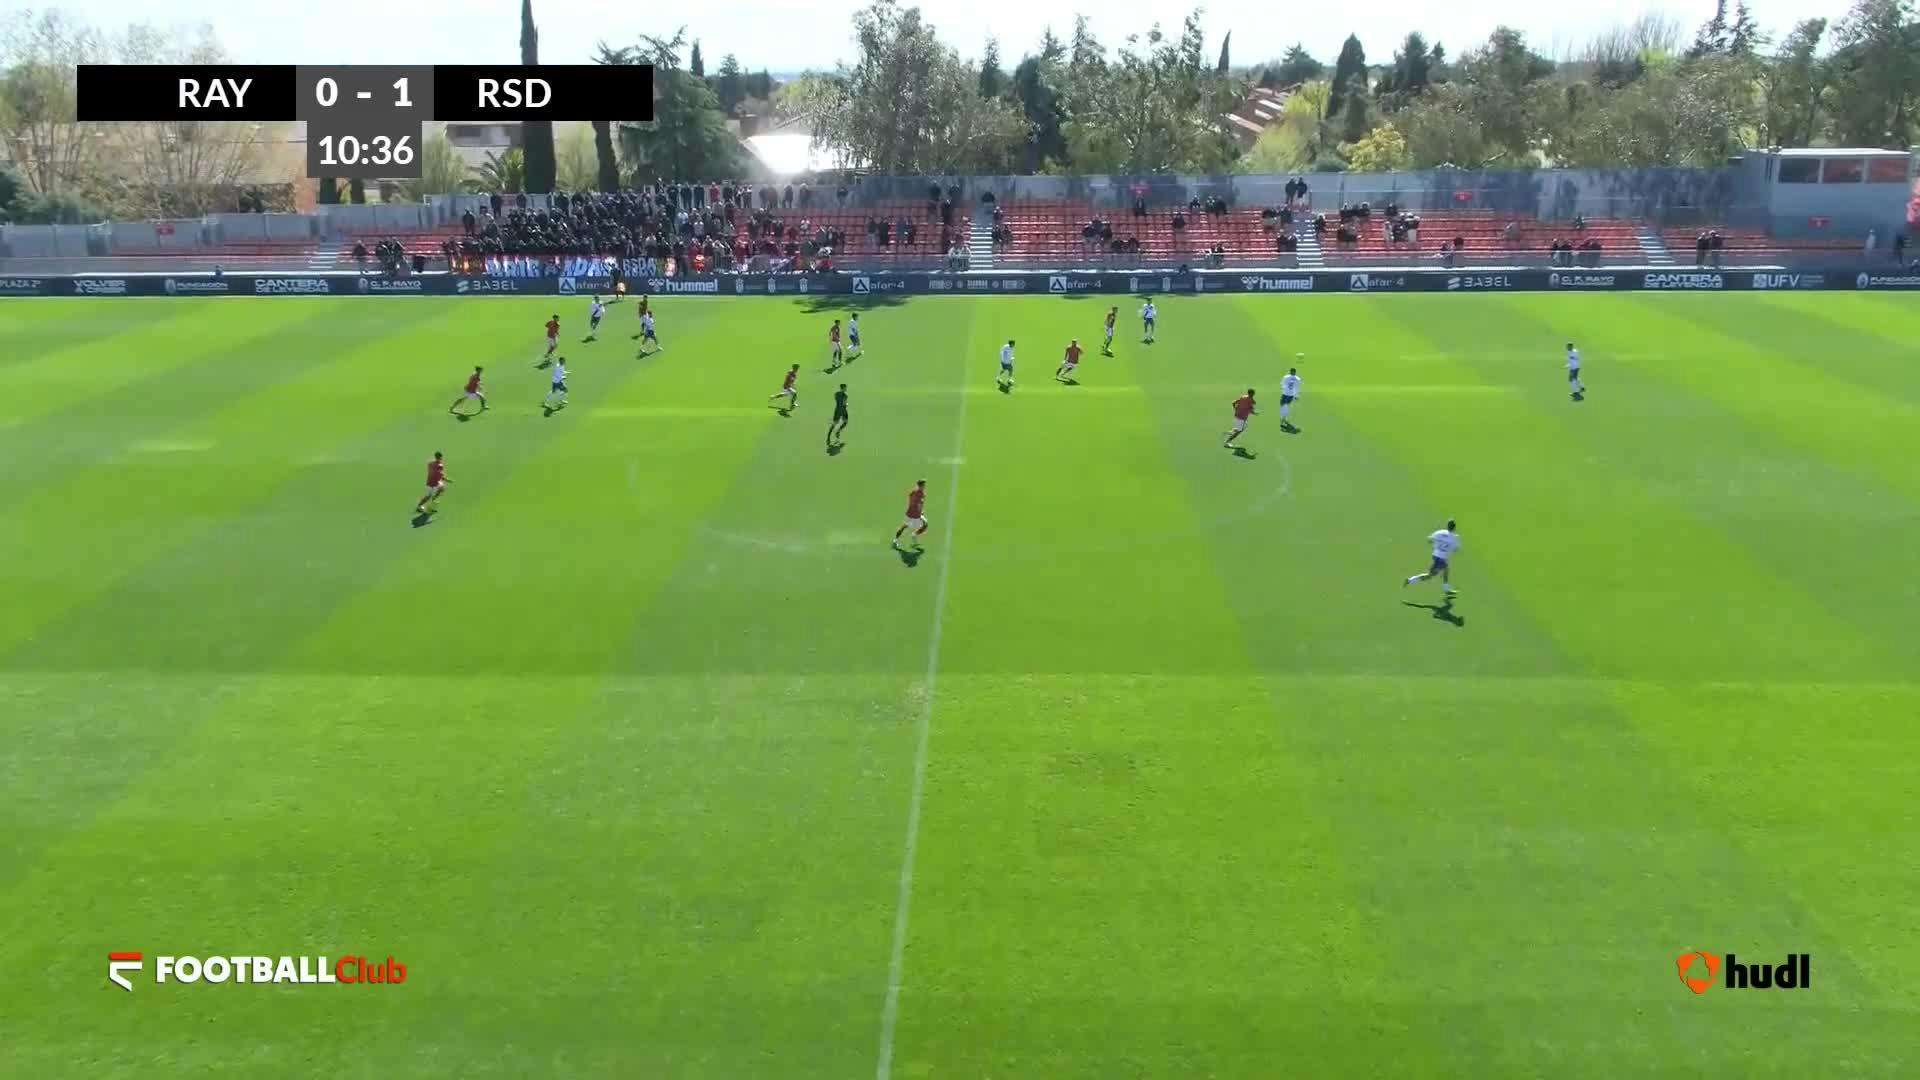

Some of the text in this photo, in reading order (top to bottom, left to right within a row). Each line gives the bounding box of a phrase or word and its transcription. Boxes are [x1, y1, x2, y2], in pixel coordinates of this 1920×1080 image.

[255, 279, 328, 287] CANTERA
[666, 279, 718, 292] hummel
[1259, 276, 1313, 289] hummel
[1768, 274, 1800, 288] UFV
